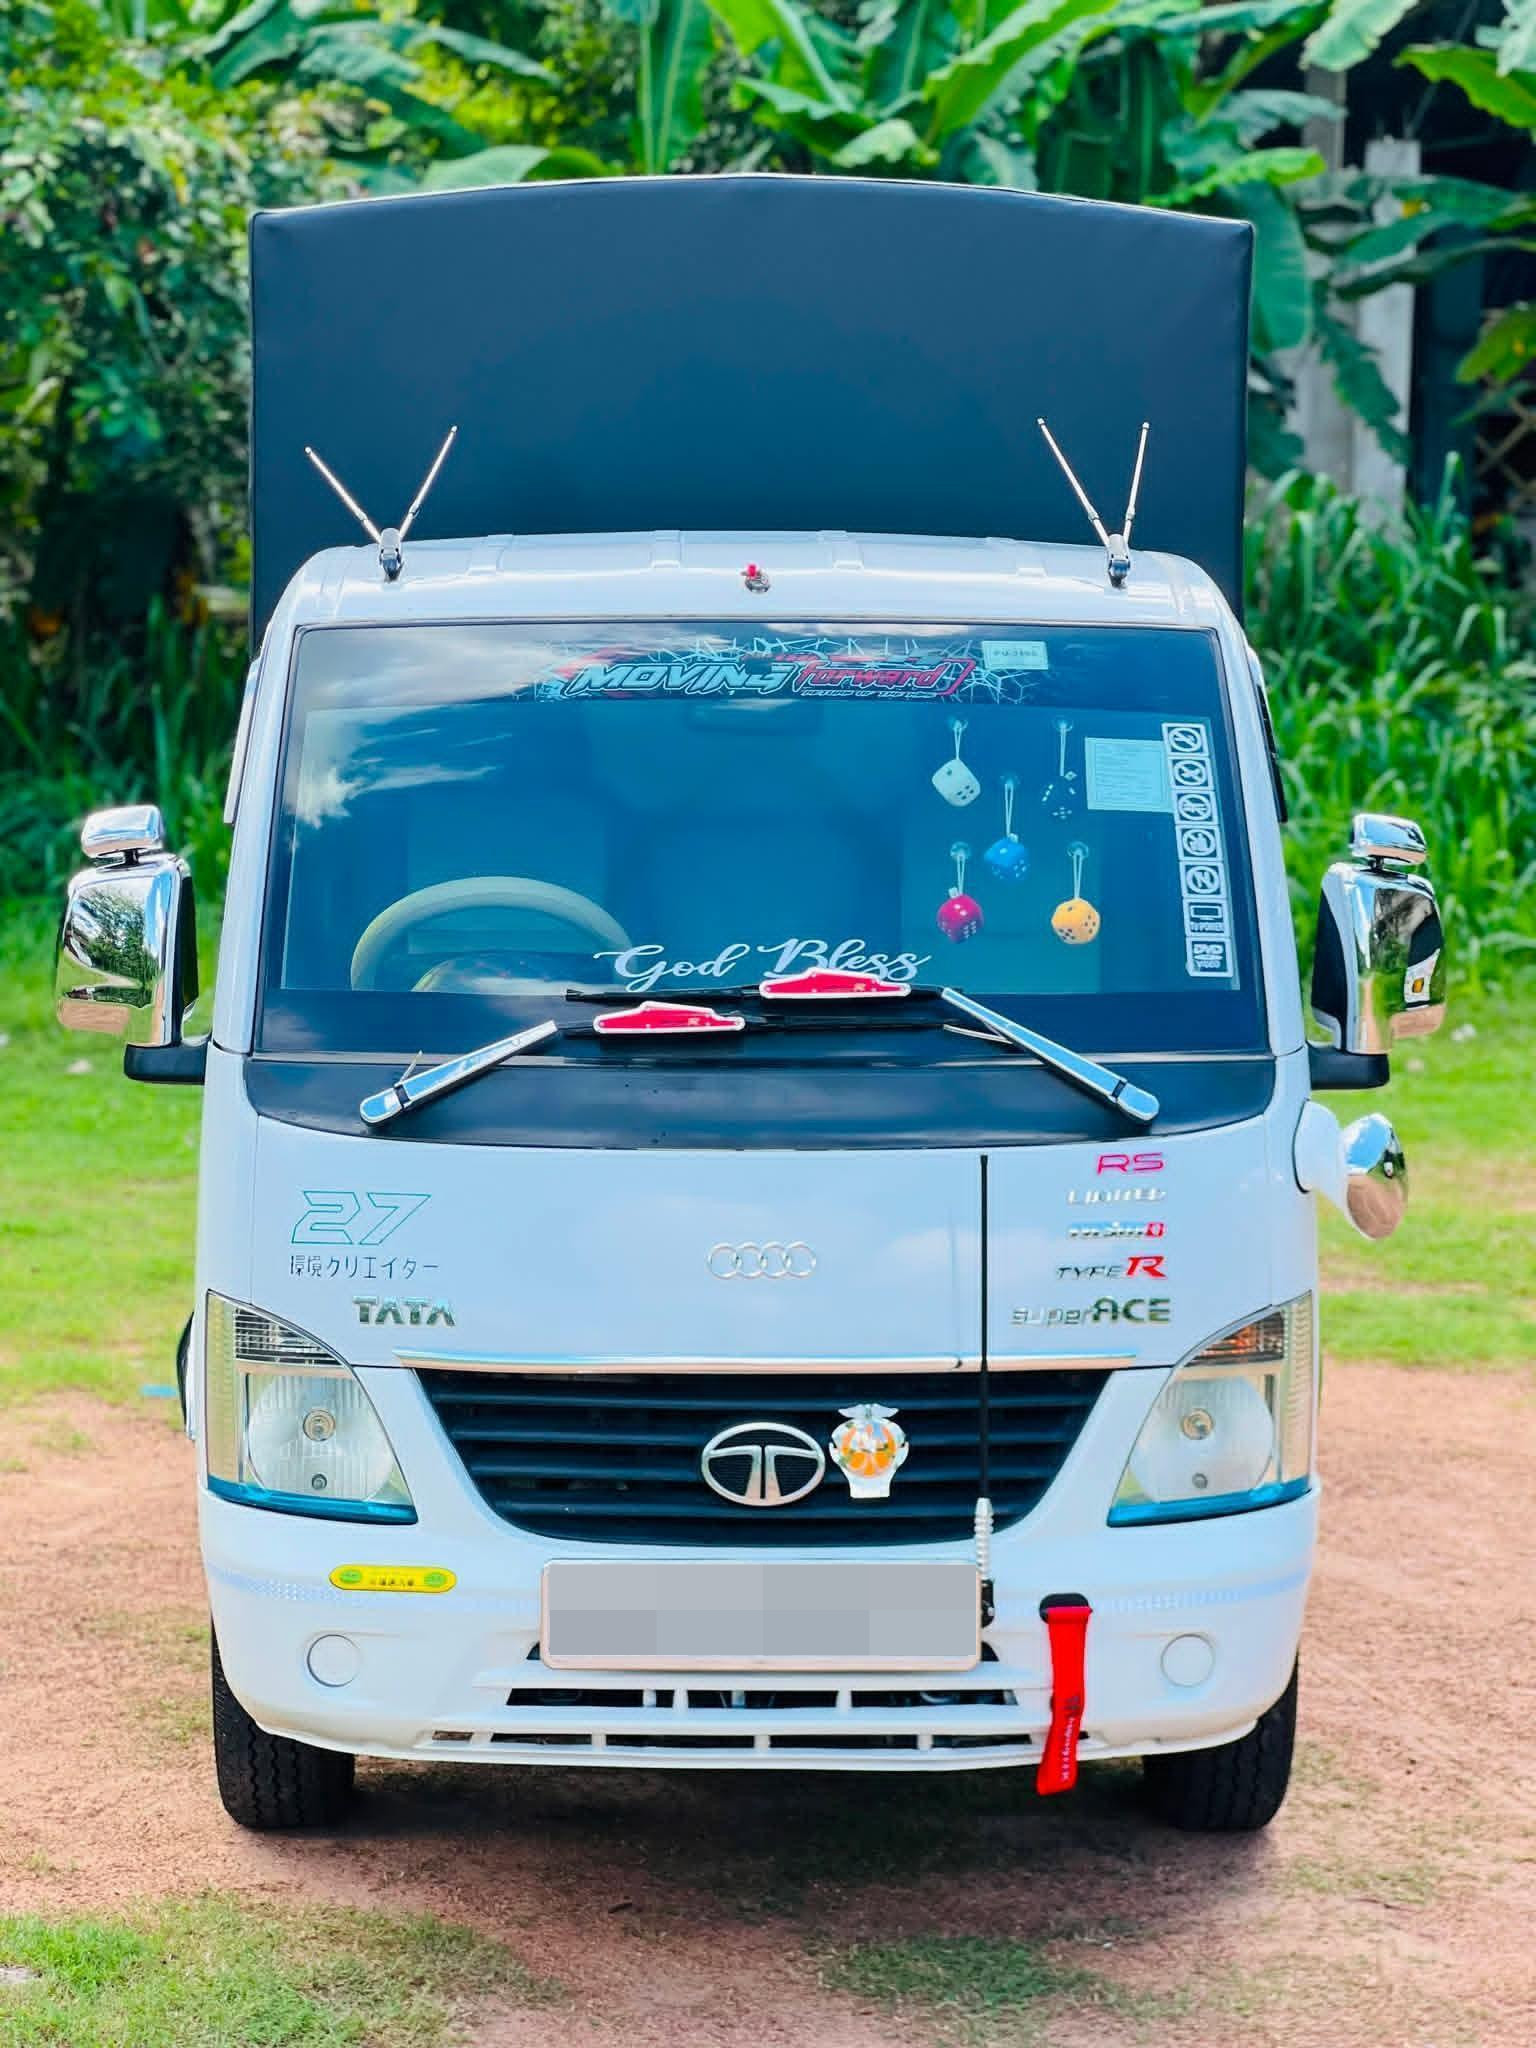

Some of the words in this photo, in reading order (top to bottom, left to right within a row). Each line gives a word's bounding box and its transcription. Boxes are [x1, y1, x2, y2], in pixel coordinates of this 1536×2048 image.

[593, 944, 750, 992] God
[757, 938, 932, 982] Bless
[1097, 1152, 1164, 1175] RS
[291, 1190, 432, 1245] 27
[289, 1255, 440, 1280] 環境クリエイター
[352, 1295, 456, 1327] TATA
